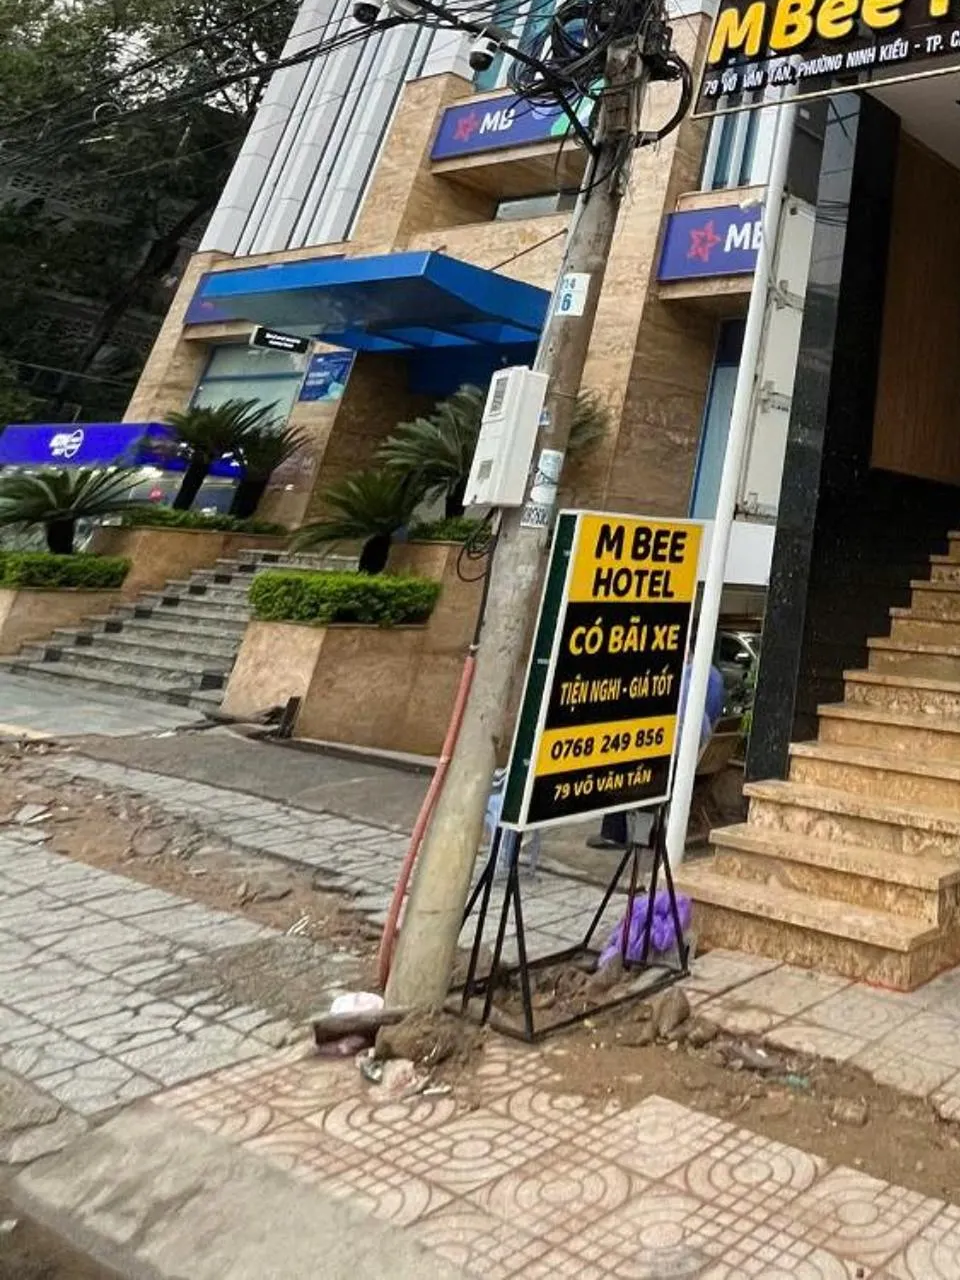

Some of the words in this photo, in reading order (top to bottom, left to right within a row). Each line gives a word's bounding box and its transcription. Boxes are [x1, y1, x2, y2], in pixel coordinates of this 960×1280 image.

[704, 79, 719, 96] 79
[846, 45, 876, 69] NINH
[925, 35, 944, 54] TP.
[479, 108, 516, 134] MB
[594, 523, 624, 561] M
[630, 526, 688, 564] BEE
[592, 567, 675, 599] HOTEL
[568, 617, 603, 656] CÓ
[608, 616, 648, 654] BÃI
[650, 623, 681, 652] XE
[560, 673, 590, 713] TIỆN
[590, 677, 622, 703] NGHI
[629, 669, 651, 700] GIÁ
[652, 663, 674, 697] TỐT
[550, 734, 594, 761] 0768
[600, 731, 630, 754] 249
[634, 727, 664, 749] 856
[554, 782, 571, 801] 79
[573, 774, 594, 797] VÕ
[597, 770, 624, 793] VĂN
[627, 762, 653, 787] TẤN
